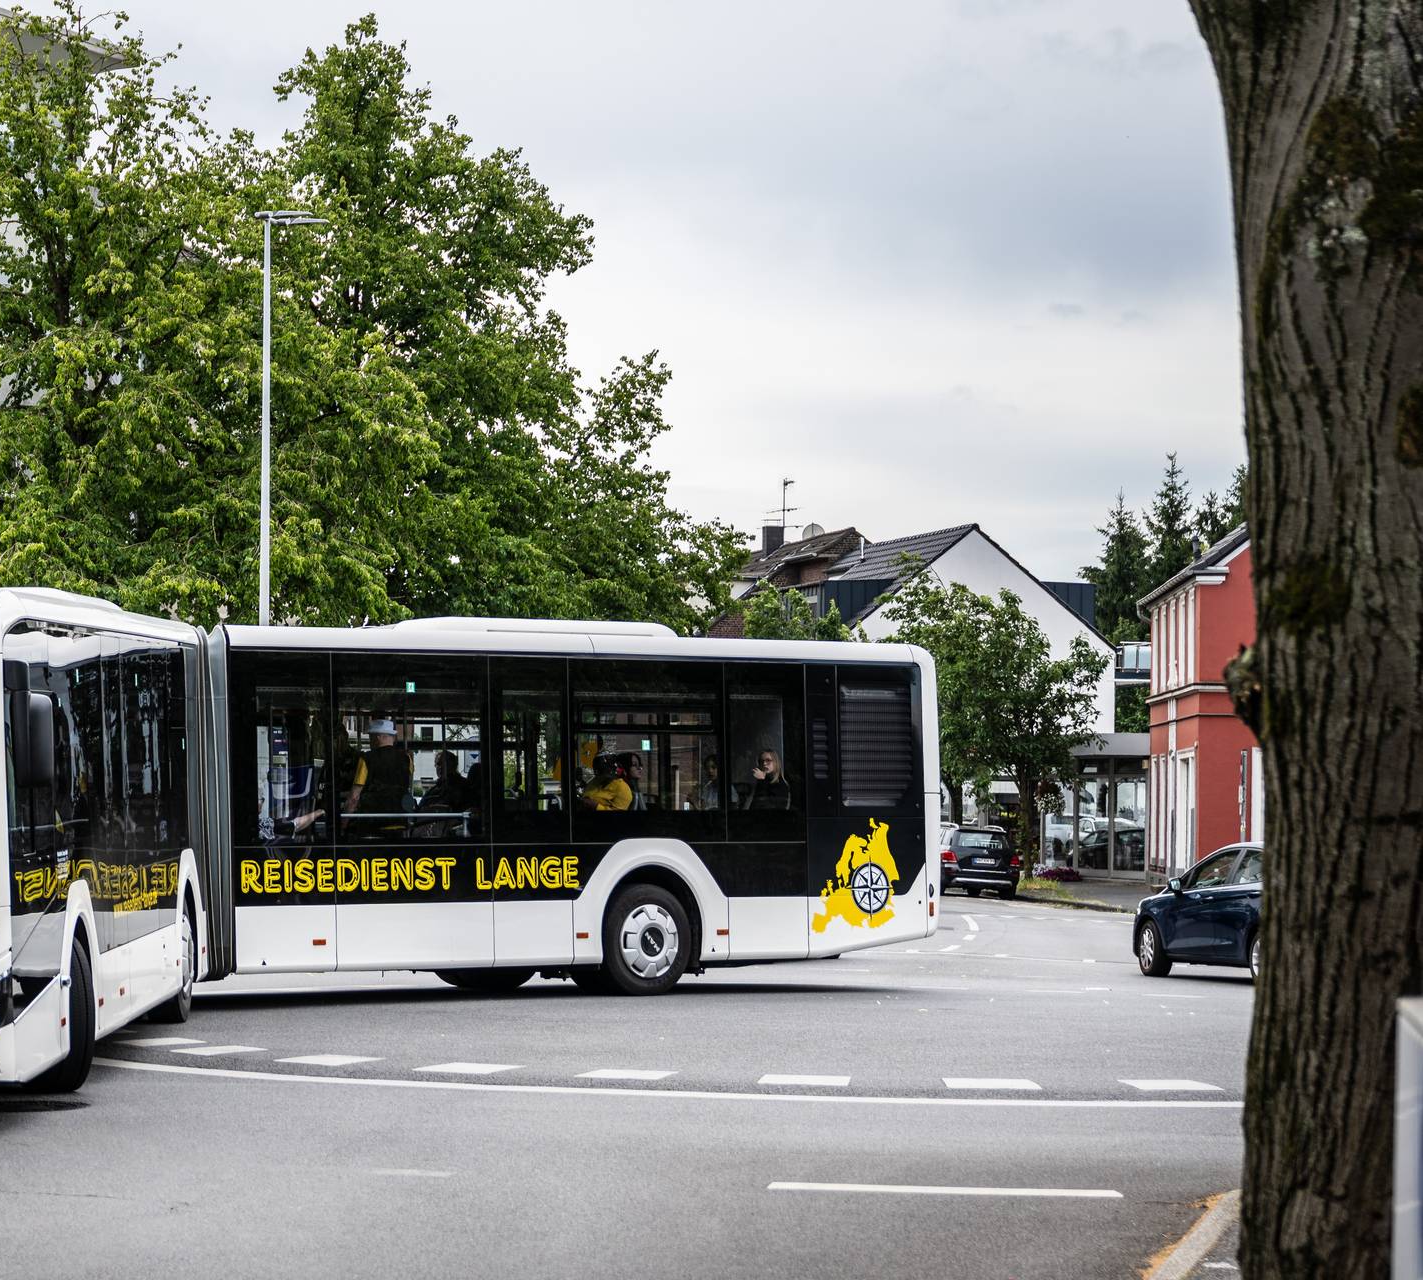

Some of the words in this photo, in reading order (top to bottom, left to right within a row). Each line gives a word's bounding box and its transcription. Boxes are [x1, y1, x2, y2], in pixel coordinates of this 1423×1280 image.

[240, 857, 456, 894] REISEDIENST
[476, 856, 580, 891] LANGE
[644, 931, 661, 953] MAN
